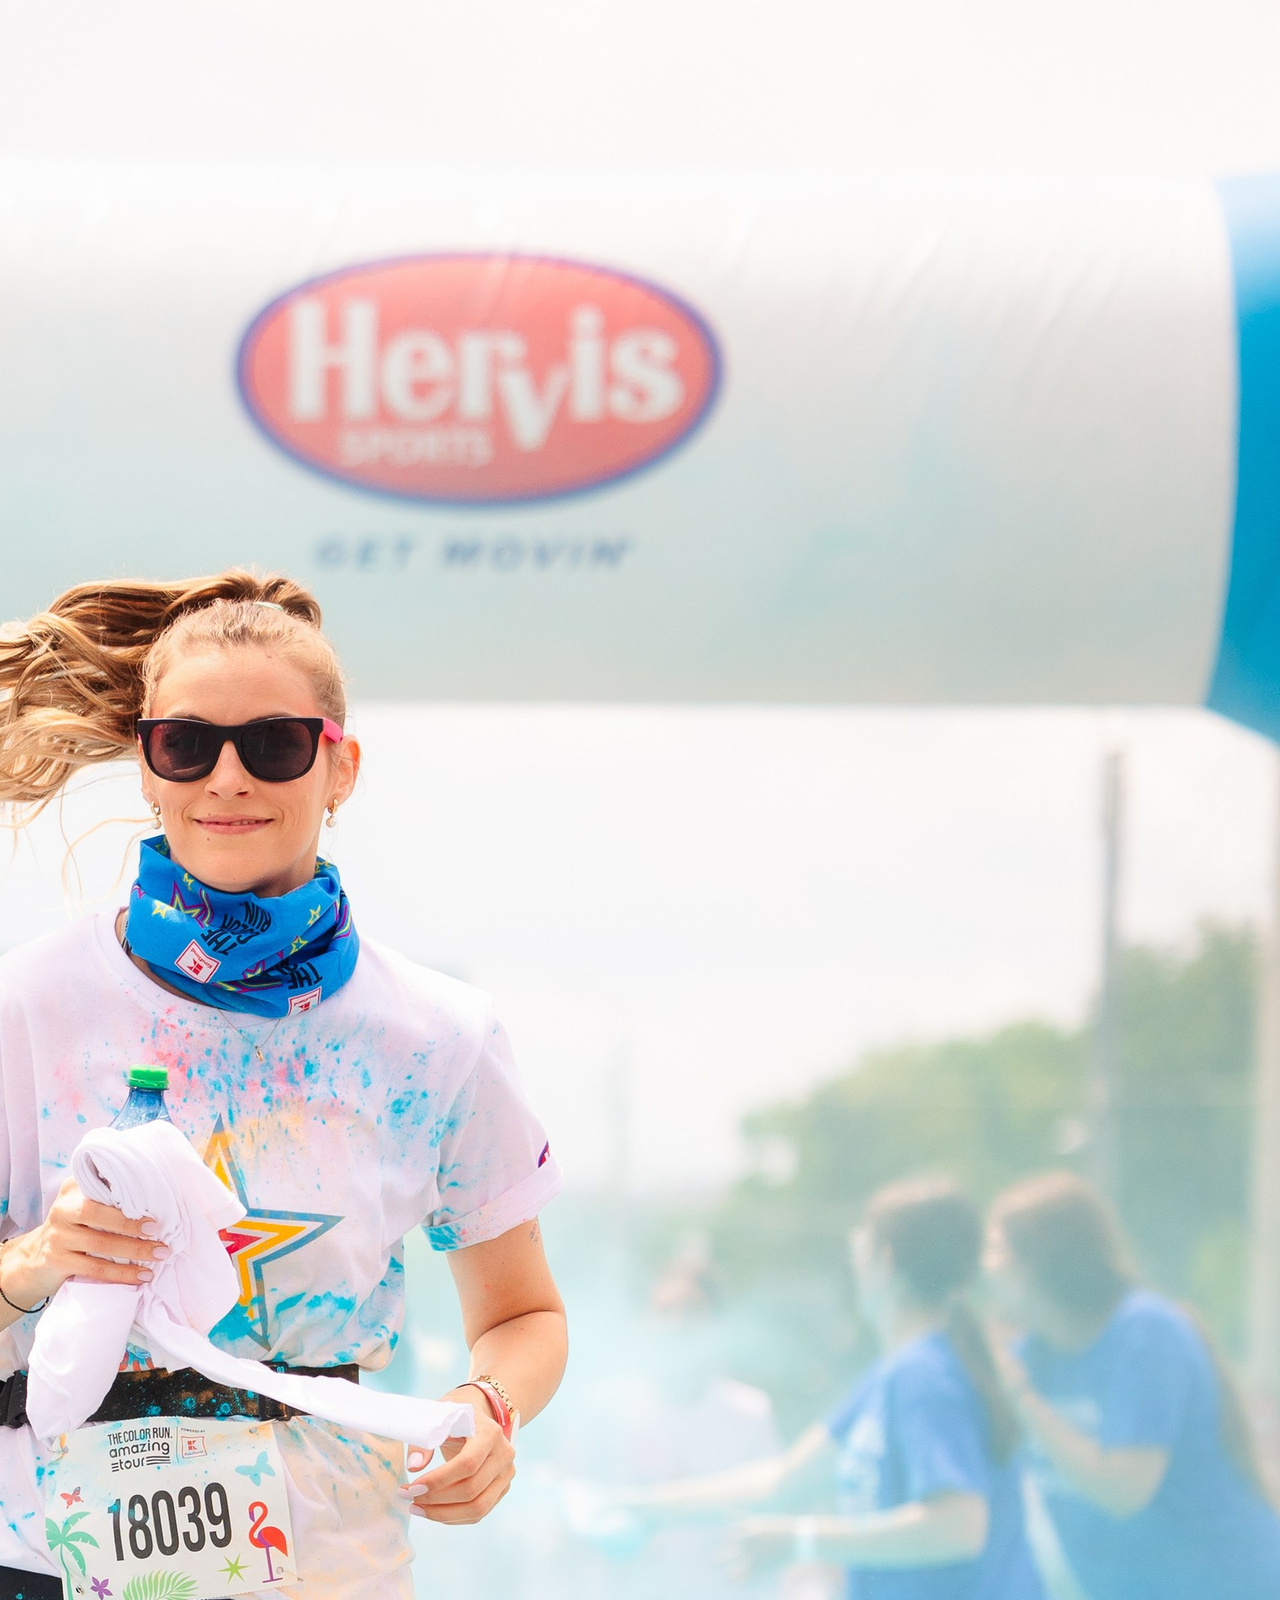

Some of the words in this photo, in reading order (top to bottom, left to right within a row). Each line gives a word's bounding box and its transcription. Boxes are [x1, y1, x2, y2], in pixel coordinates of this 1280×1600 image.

[288, 295, 685, 451] Hervis
[337, 429, 495, 468] SPORTS
[314, 535, 419, 570] GET
[107, 1432, 123, 1446] THE
[123, 1427, 151, 1443] COLOR
[109, 1439, 170, 1458] amazing
[119, 1457, 145, 1471] tour
[107, 1481, 233, 1562] 18039
